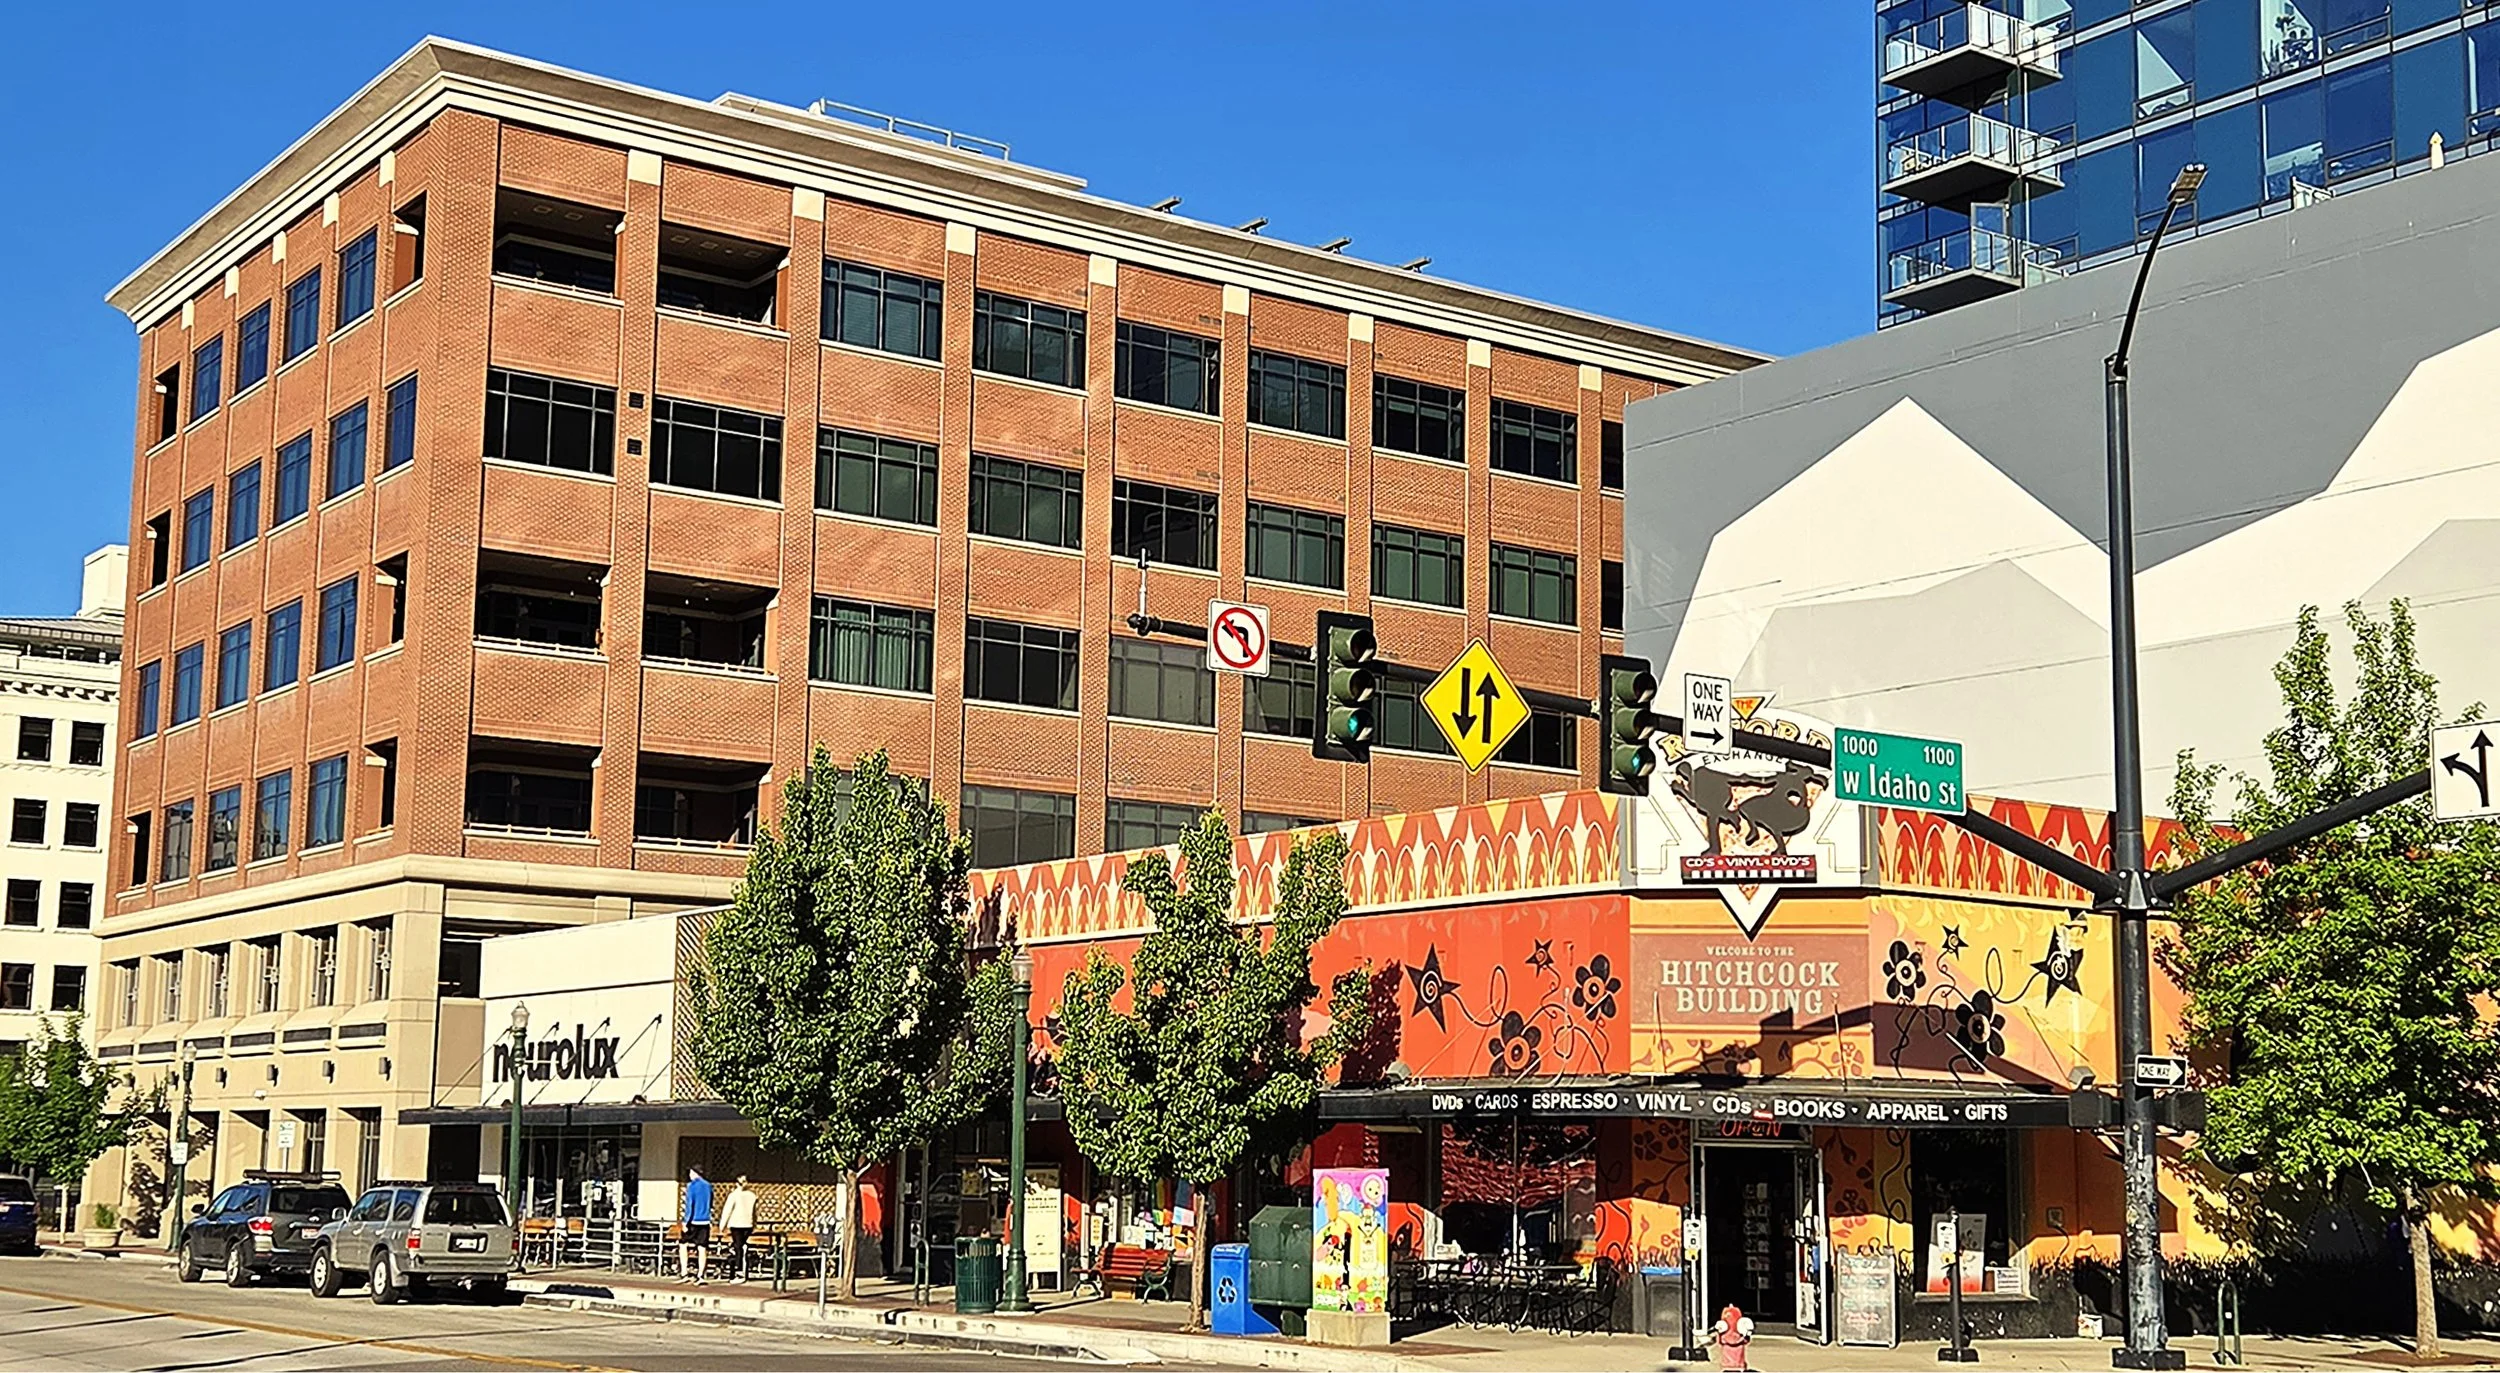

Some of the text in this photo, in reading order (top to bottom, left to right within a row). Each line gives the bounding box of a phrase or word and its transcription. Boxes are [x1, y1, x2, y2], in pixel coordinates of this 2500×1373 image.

[1692, 681, 1723, 702] ONE
[1692, 702, 1724, 723] WAY
[1842, 735, 1955, 766] 1000 1100
[1842, 763, 1957, 806] W Idaho St
[1686, 857, 1810, 867] CD'S VINYL DVD'S
[1707, 946, 1794, 956] WELCOME TO THE
[1660, 960, 1840, 987] HITCHCOCK
[1676, 987, 1823, 1014] BUILDING
[493, 1024, 620, 1082] nurolux
[1432, 1093, 2008, 1121] DVDs CARDS ESPRESSO VINYL CDs BOOKS APPAREL GIFTS
